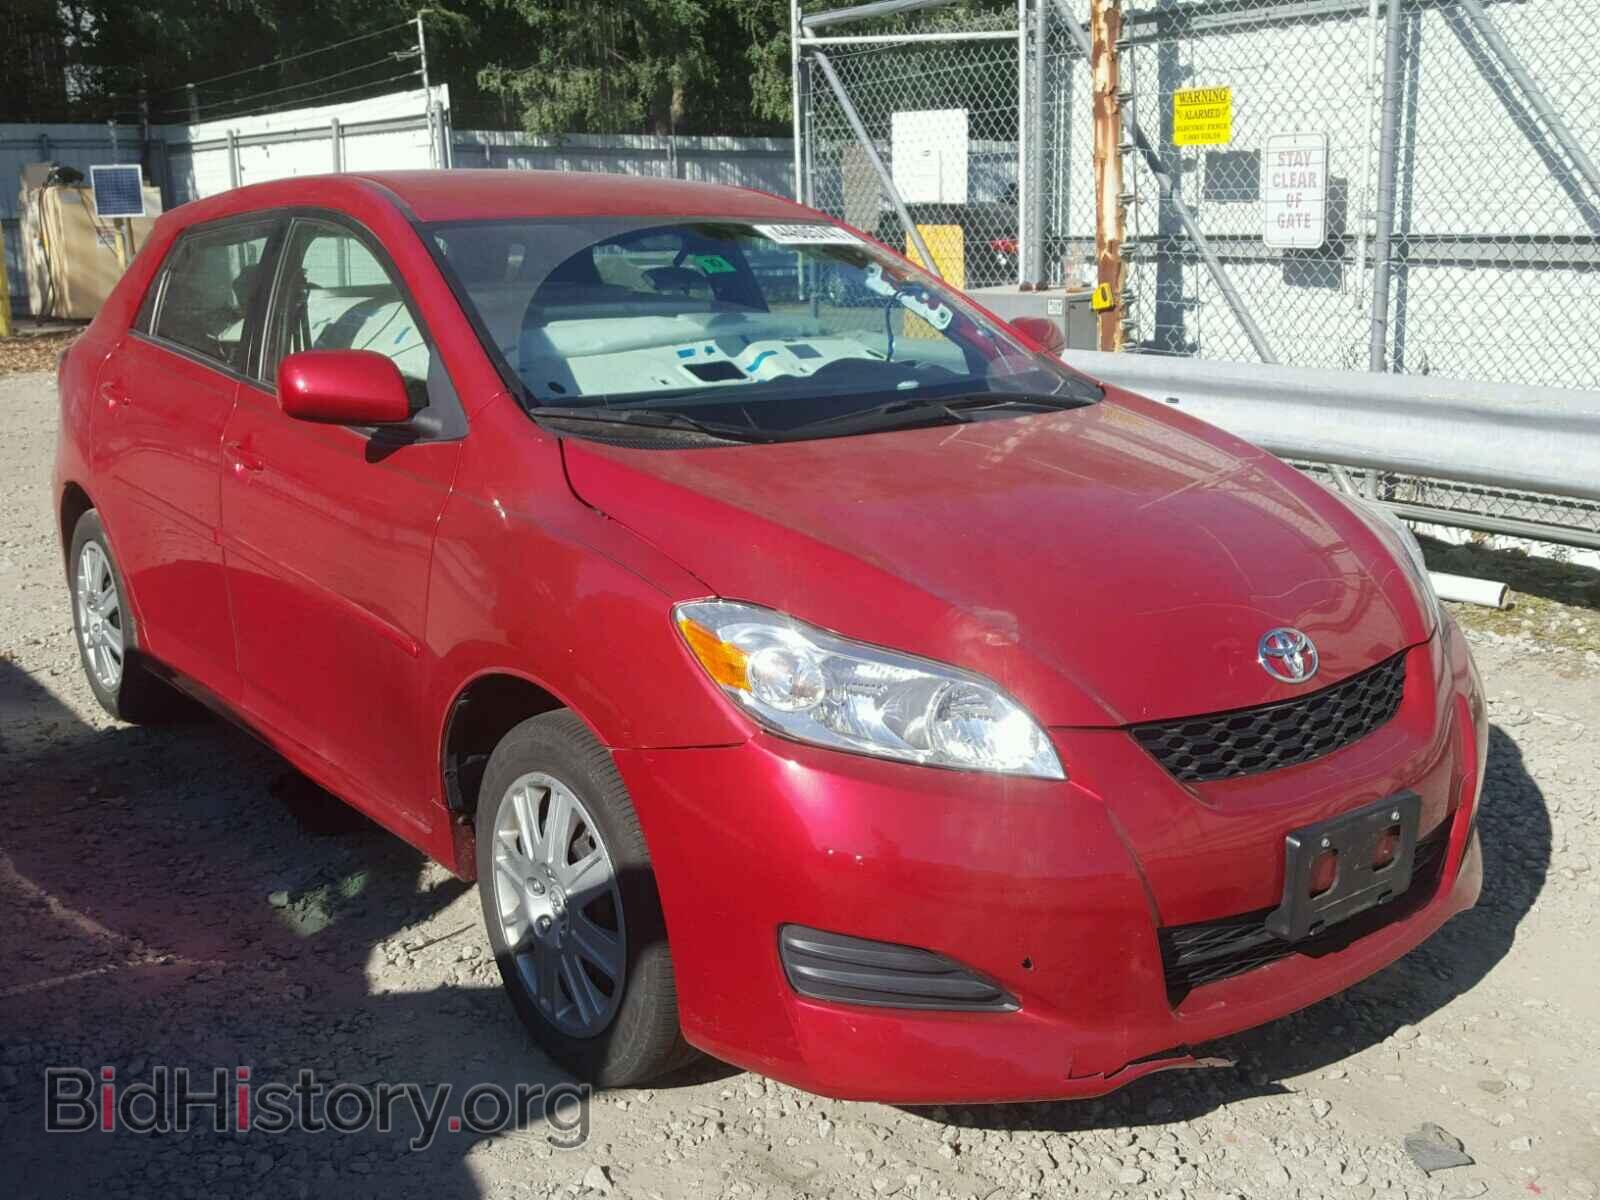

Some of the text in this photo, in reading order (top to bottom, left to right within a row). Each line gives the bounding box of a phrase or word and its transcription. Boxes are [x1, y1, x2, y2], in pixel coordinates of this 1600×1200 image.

[1179, 88, 1227, 104] WARNING
[1184, 108, 1222, 120] ALARMED
[1278, 151, 1313, 168] STAY
[1272, 172, 1318, 189] CLEAR
[1286, 192, 1303, 209] OF
[1277, 213, 1312, 229] GATE
